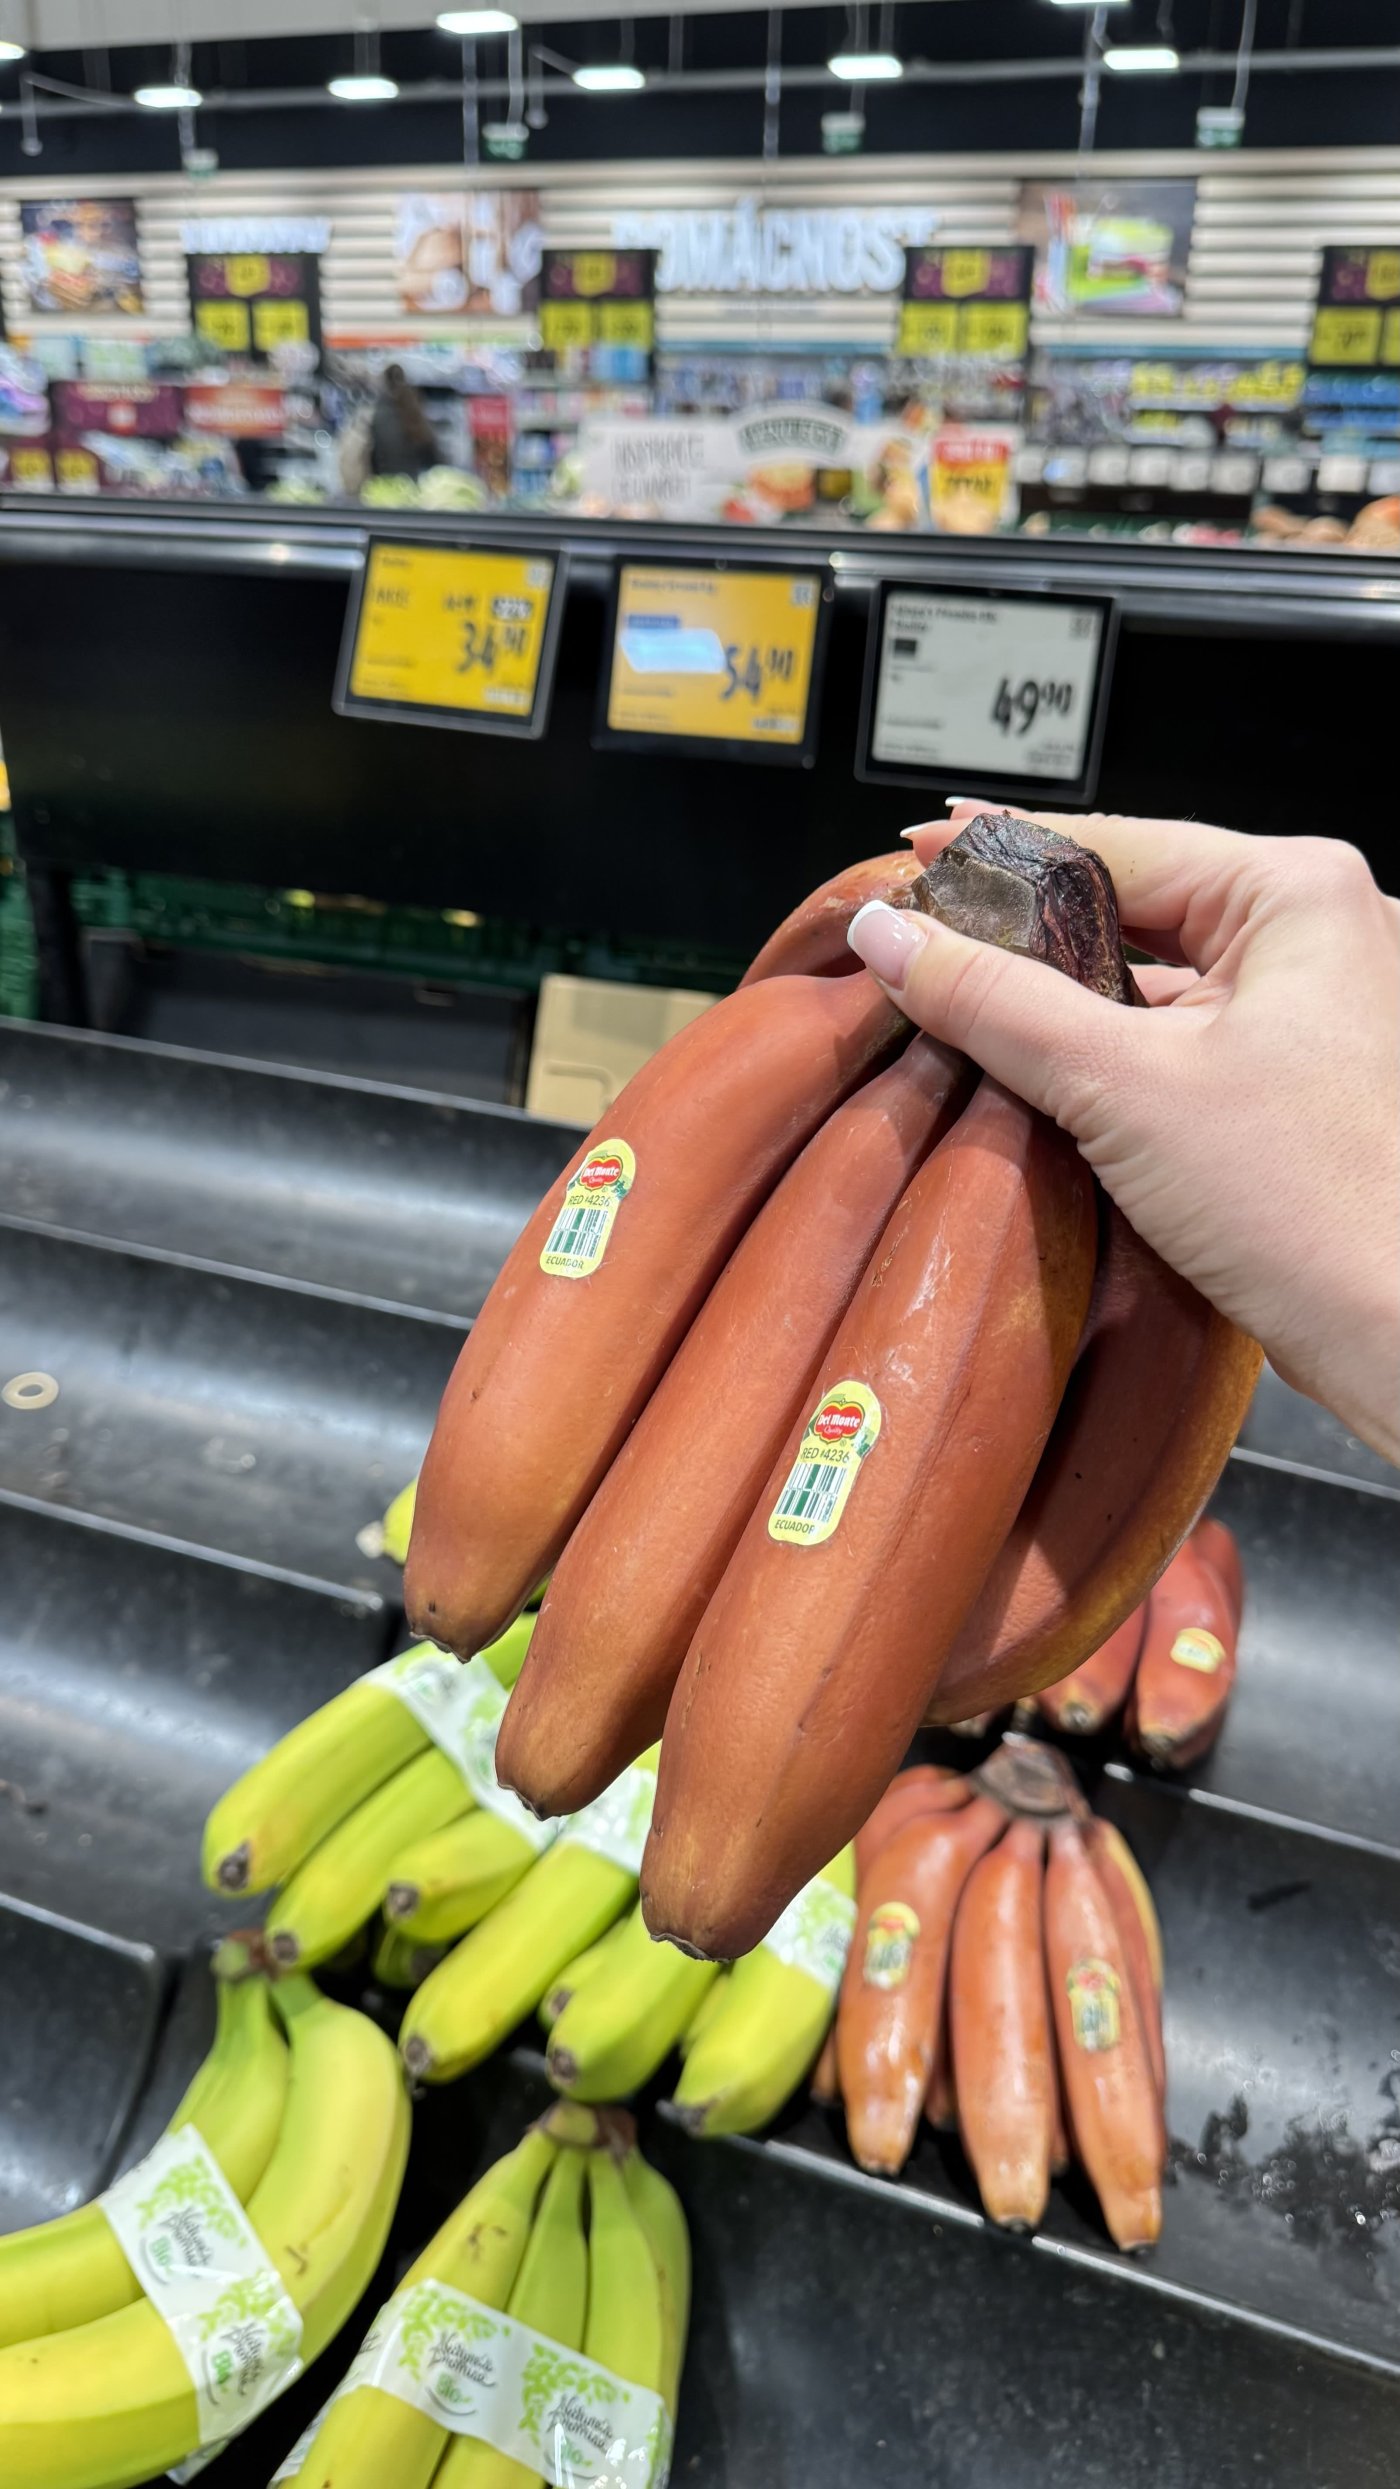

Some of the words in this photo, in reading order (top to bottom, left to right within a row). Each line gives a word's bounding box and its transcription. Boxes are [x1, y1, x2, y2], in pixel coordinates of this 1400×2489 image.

[583, 1168, 594, 1178] Del
[594, 1165, 620, 1178] Monte
[567, 1194, 584, 1206] RED
[546, 1254, 585, 1270] ECUADOR
[818, 1413, 832, 1426] Del
[832, 1413, 861, 1428] Monte
[800, 1447, 820, 1460] RED
